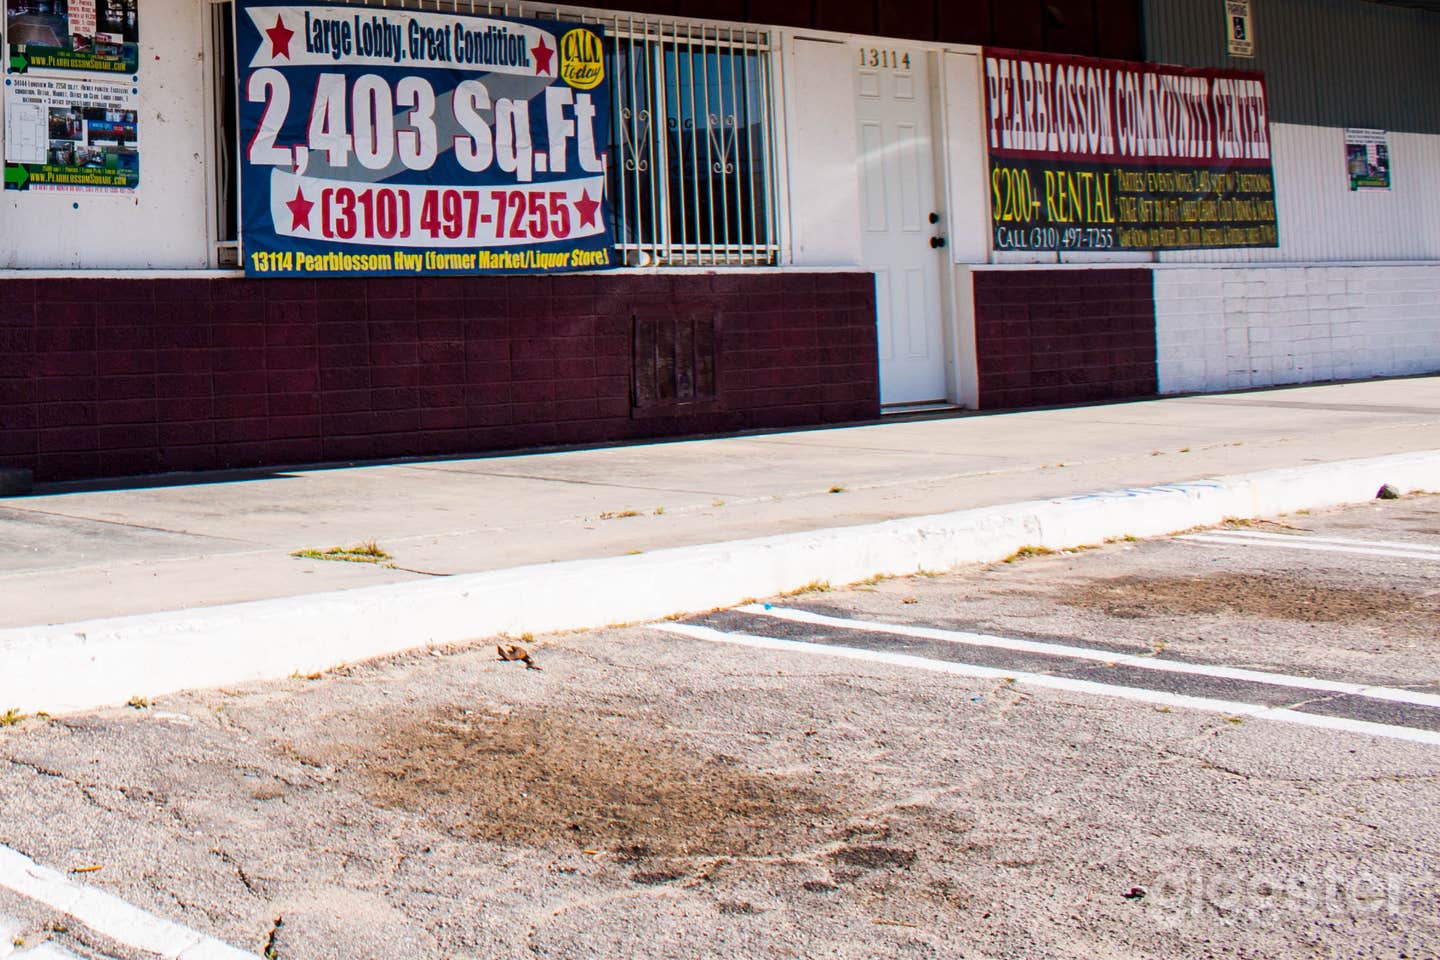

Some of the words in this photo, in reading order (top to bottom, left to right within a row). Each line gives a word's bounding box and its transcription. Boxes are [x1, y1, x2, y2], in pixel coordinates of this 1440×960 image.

[304, 10, 352, 59] Large
[354, 14, 407, 64] Lobby.
[408, 18, 452, 62] Great
[453, 21, 531, 68] Condition.
[564, 30, 600, 64] CALL
[859, 47, 911, 70] 13114
[563, 62, 602, 81] today
[245, 68, 438, 177] 2,403
[986, 57, 1114, 155] PEARBLOSSOM
[1115, 70, 1212, 158] COMMUNITY
[1212, 77, 1270, 159] CENTER
[319, 187, 411, 239] (310)
[420, 189, 572, 240] 497-7255
[992, 161, 1041, 226] $200+
[1044, 170, 1115, 223] RENTAL
[997, 226, 1027, 248] CALL
[1030, 226, 1060, 249] (310)
[1062, 227, 1113, 249] 497-7255
[251, 252, 293, 272] 13114
[295, 251, 391, 272] Pearblossom
[393, 252, 423, 272] Hwy
[426, 250, 477, 271] (former
[478, 249, 569, 270] Market/Liquor
[571, 247, 610, 267] Store)
